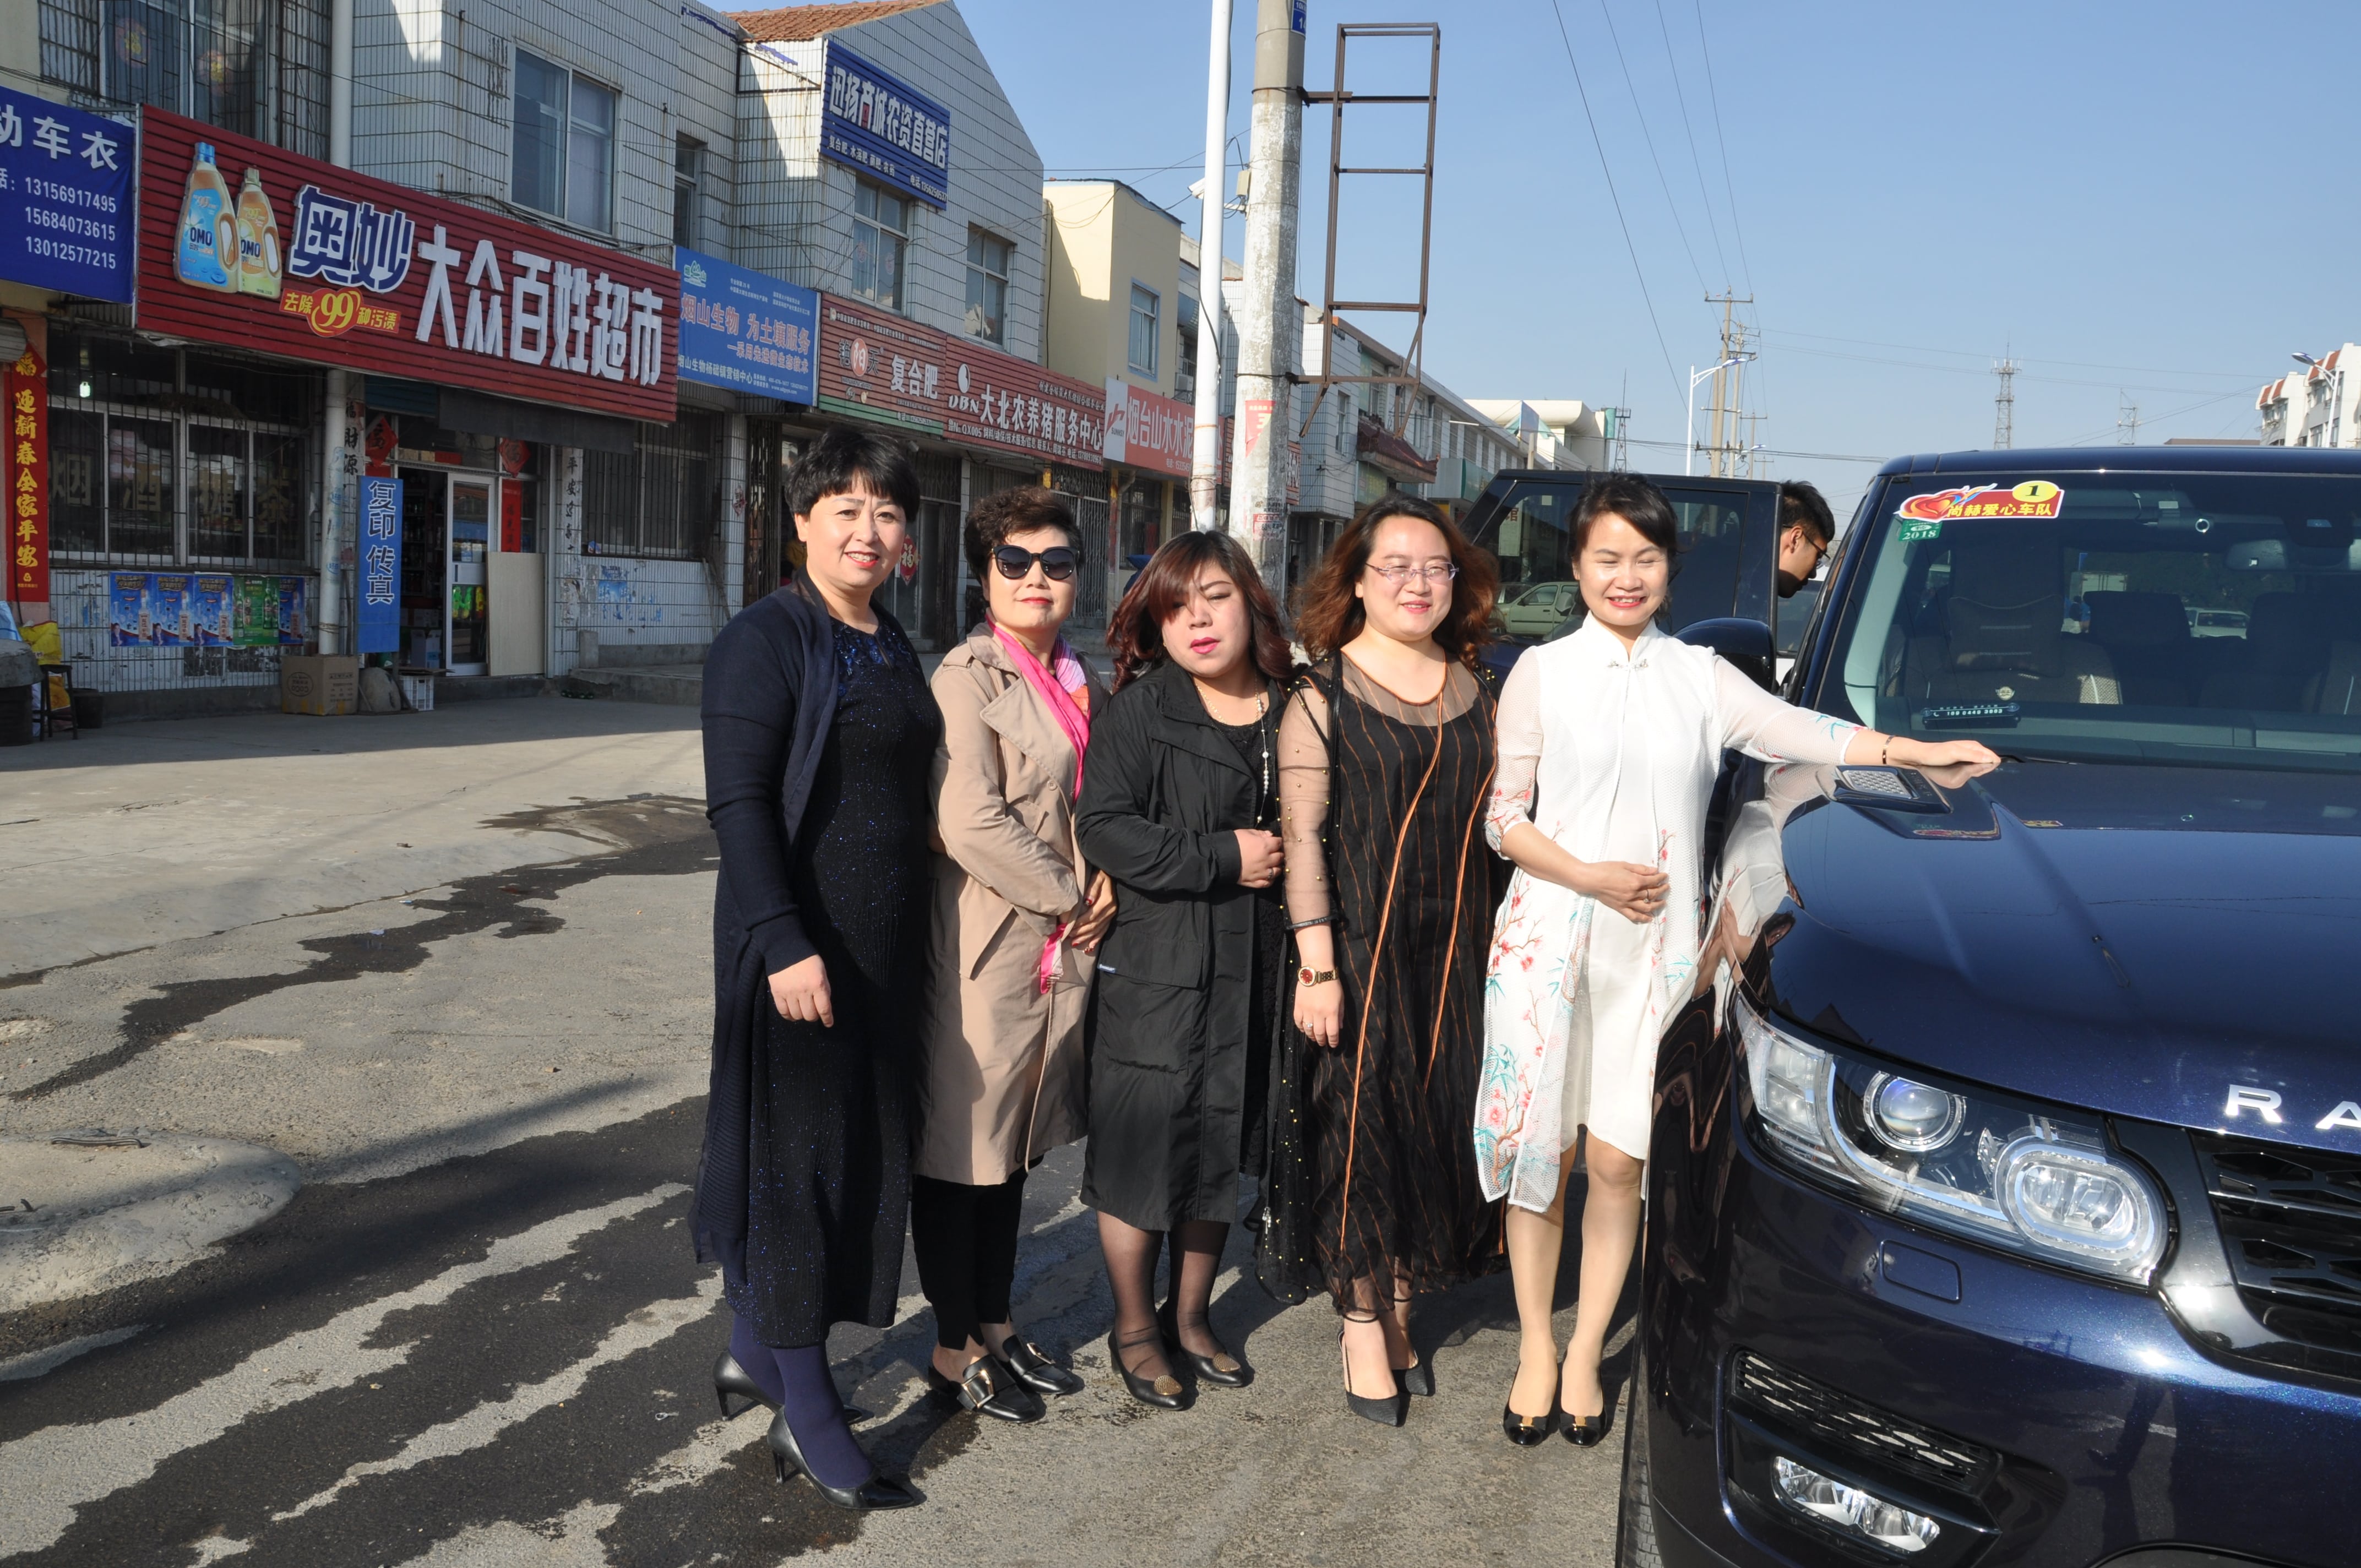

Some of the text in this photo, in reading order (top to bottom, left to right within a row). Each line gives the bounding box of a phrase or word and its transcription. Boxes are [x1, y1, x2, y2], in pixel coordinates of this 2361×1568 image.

[25, 176, 116, 213] 13156917495
[25, 206, 116, 241] 15684073615
[190, 227, 213, 247] OMO
[291, 185, 414, 292] 奥妙
[26, 236, 116, 269] 13012577215
[241, 239, 260, 257] OMO
[415, 224, 663, 386] 大众百姓超市
[680, 292, 810, 356] 烟山生物 为土壤服务
[890, 354, 938, 399] 复合肥
[980, 384, 1102, 450] 大北农养猪服务中心
[2025, 484, 2040, 497] 1
[368, 481, 396, 540] 复印
[1946, 503, 2053, 517] 尚赫爱心车队
[1902, 530, 1937, 540] 2018
[366, 545, 395, 605] 传真
[1888, 1132, 1937, 1145] RANGE ROVER
